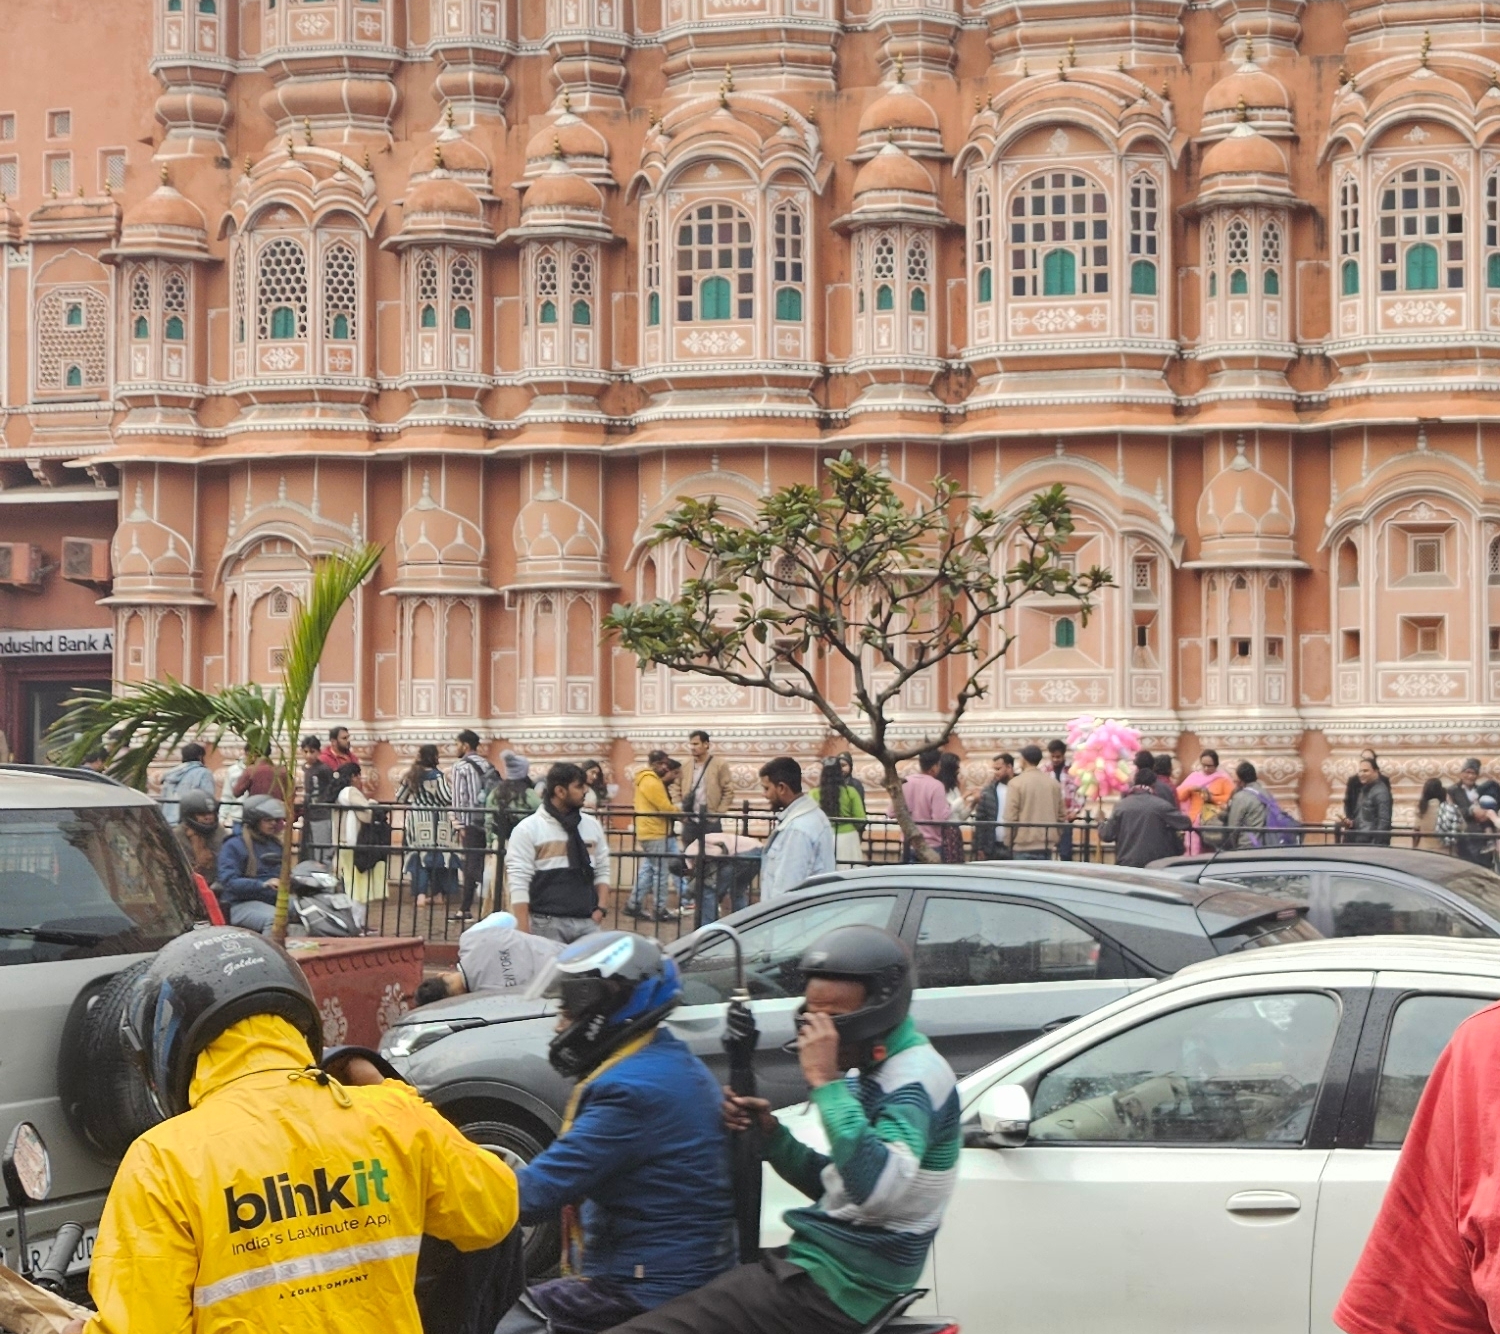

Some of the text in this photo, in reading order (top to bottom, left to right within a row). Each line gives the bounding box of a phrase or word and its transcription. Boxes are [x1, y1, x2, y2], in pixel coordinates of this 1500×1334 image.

[58, 634, 98, 652] Bank
[223, 1158, 391, 1234] blinkit
[232, 1233, 284, 1255] India's
[326, 1274, 369, 1291] OMPANY
